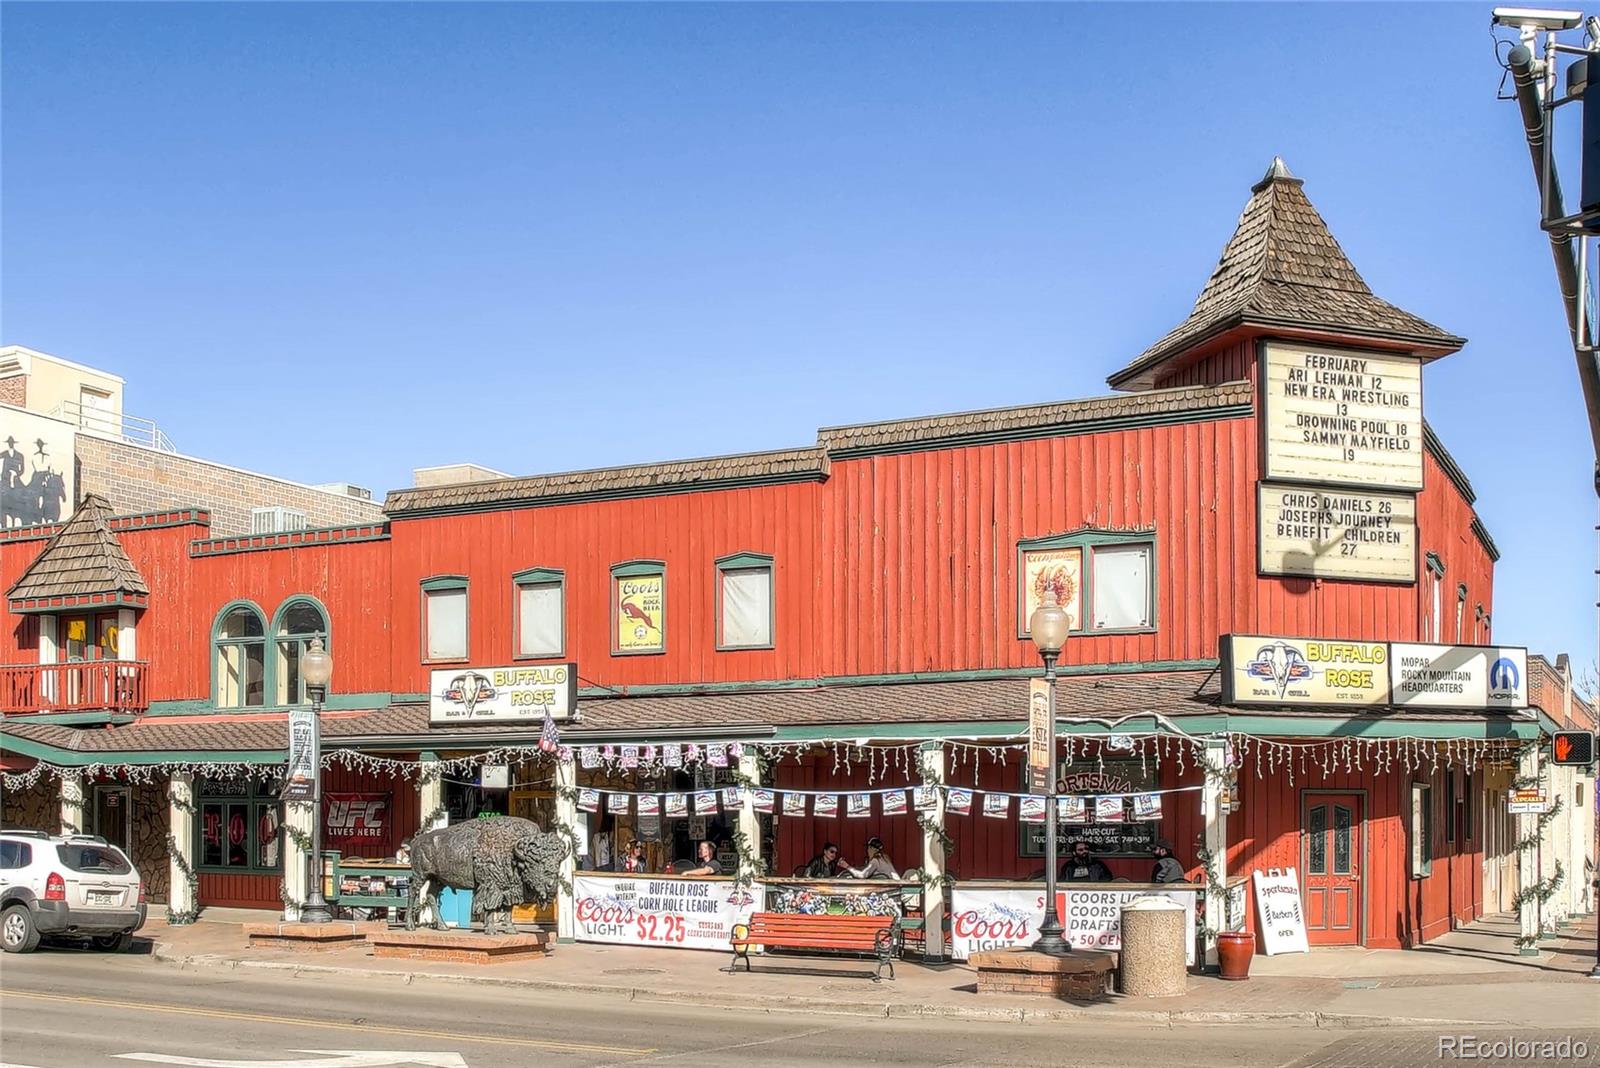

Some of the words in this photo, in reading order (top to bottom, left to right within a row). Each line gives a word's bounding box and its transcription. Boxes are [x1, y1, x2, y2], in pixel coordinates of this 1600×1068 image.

[1305, 354, 1367, 373] FEBRUARY
[1288, 368, 1308, 382] ARI
[1315, 369, 1363, 387] LEHMAN
[1371, 377, 1382, 390] 12
[1284, 383, 1308, 397] NEW
[1313, 385, 1336, 400] ERA
[1342, 389, 1409, 407] WRESTLING
[1336, 403, 1348, 416] 13
[1297, 413, 1357, 432] DROWNING
[1361, 420, 1390, 435] POOL
[1396, 423, 1407, 436] 18
[1303, 430, 1346, 447] SAMMY
[1350, 434, 1410, 450] MAYFIELD
[1343, 448, 1355, 461] 19
[1282, 494, 1318, 509] CHRIS
[1324, 497, 1372, 512] DANIELS
[1378, 500, 1392, 514] 26
[1279, 509, 1333, 525] JOSEPHS
[1336, 513, 1392, 529] JOURNEY
[1277, 524, 1330, 540] BENEFIT
[1344, 528, 1400, 543] CHILDREN
[1340, 543, 1357, 556] 27
[1307, 642, 1386, 664] BUFFALO
[1401, 656, 1430, 669] MOPAR
[493, 668, 566, 687] BUFFALO
[1325, 669, 1374, 690] ROSE
[1401, 669, 1428, 681] ROCKY
[1429, 670, 1472, 682] MOUNTAIN
[511, 689, 556, 706] ROSE
[1401, 682, 1464, 695] HEADQUARTERS
[327, 800, 386, 828] UFC
[328, 828, 355, 836] LIVES
[357, 828, 382, 837] HERE
[649, 881, 685, 897] BUFFALO
[686, 883, 709, 898] ROSE
[1070, 893, 1116, 905] COORS
[576, 896, 635, 925] Coors
[638, 897, 661, 911] CORN
[662, 898, 684, 912] HOLE
[686, 899, 718, 914] LEAGUE
[1070, 906, 1116, 918] COORS
[636, 914, 686, 943] $2.25
[953, 910, 1031, 940] Coors
[1070, 919, 1120, 931] DRAFTS
[1080, 935, 1095, 945] 50
